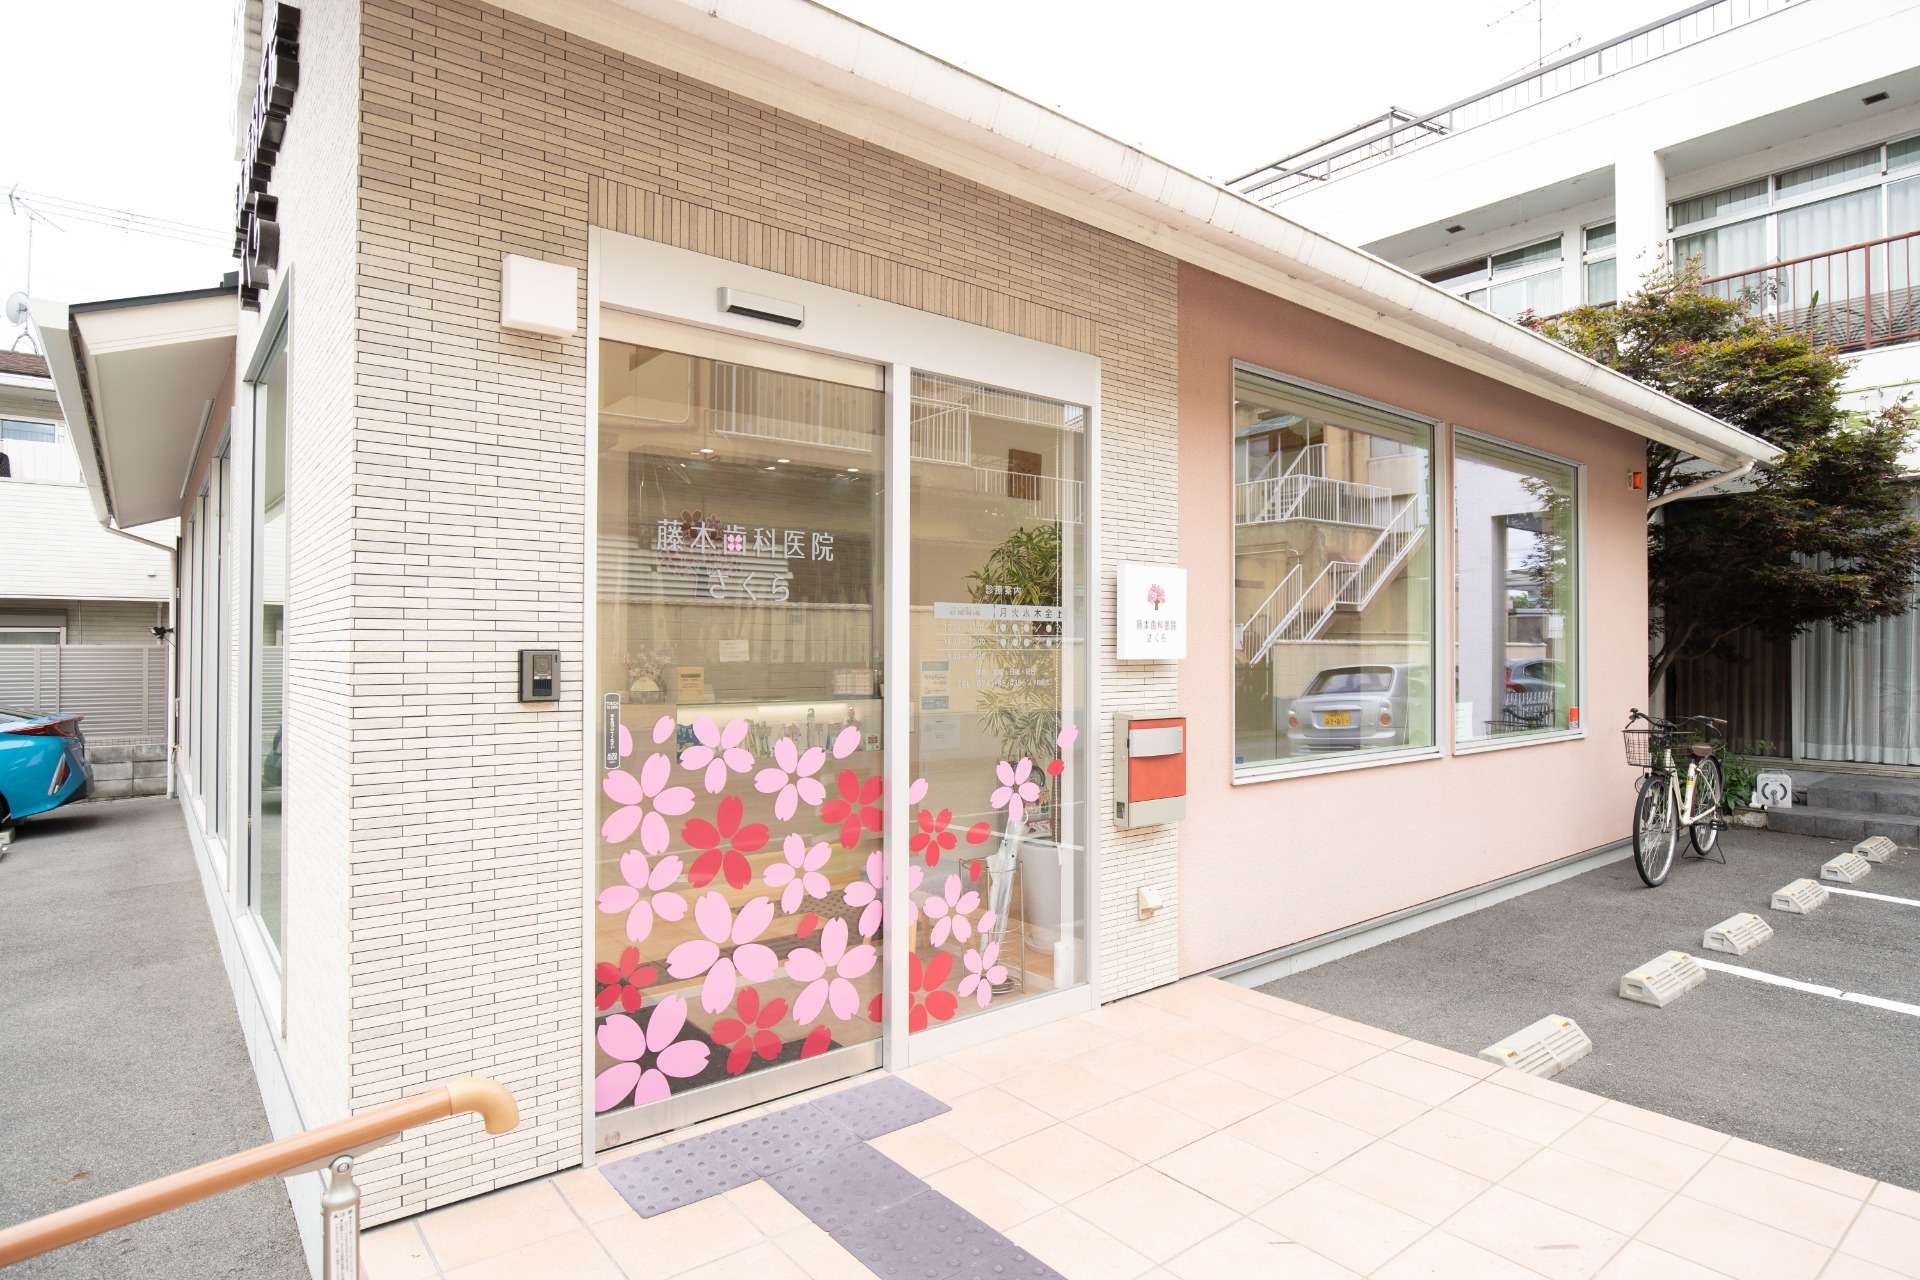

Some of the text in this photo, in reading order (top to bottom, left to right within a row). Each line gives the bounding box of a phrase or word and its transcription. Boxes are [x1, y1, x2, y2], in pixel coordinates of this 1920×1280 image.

[656, 517, 834, 562] 藤本歯科医院
[709, 569, 790, 602] さくら
